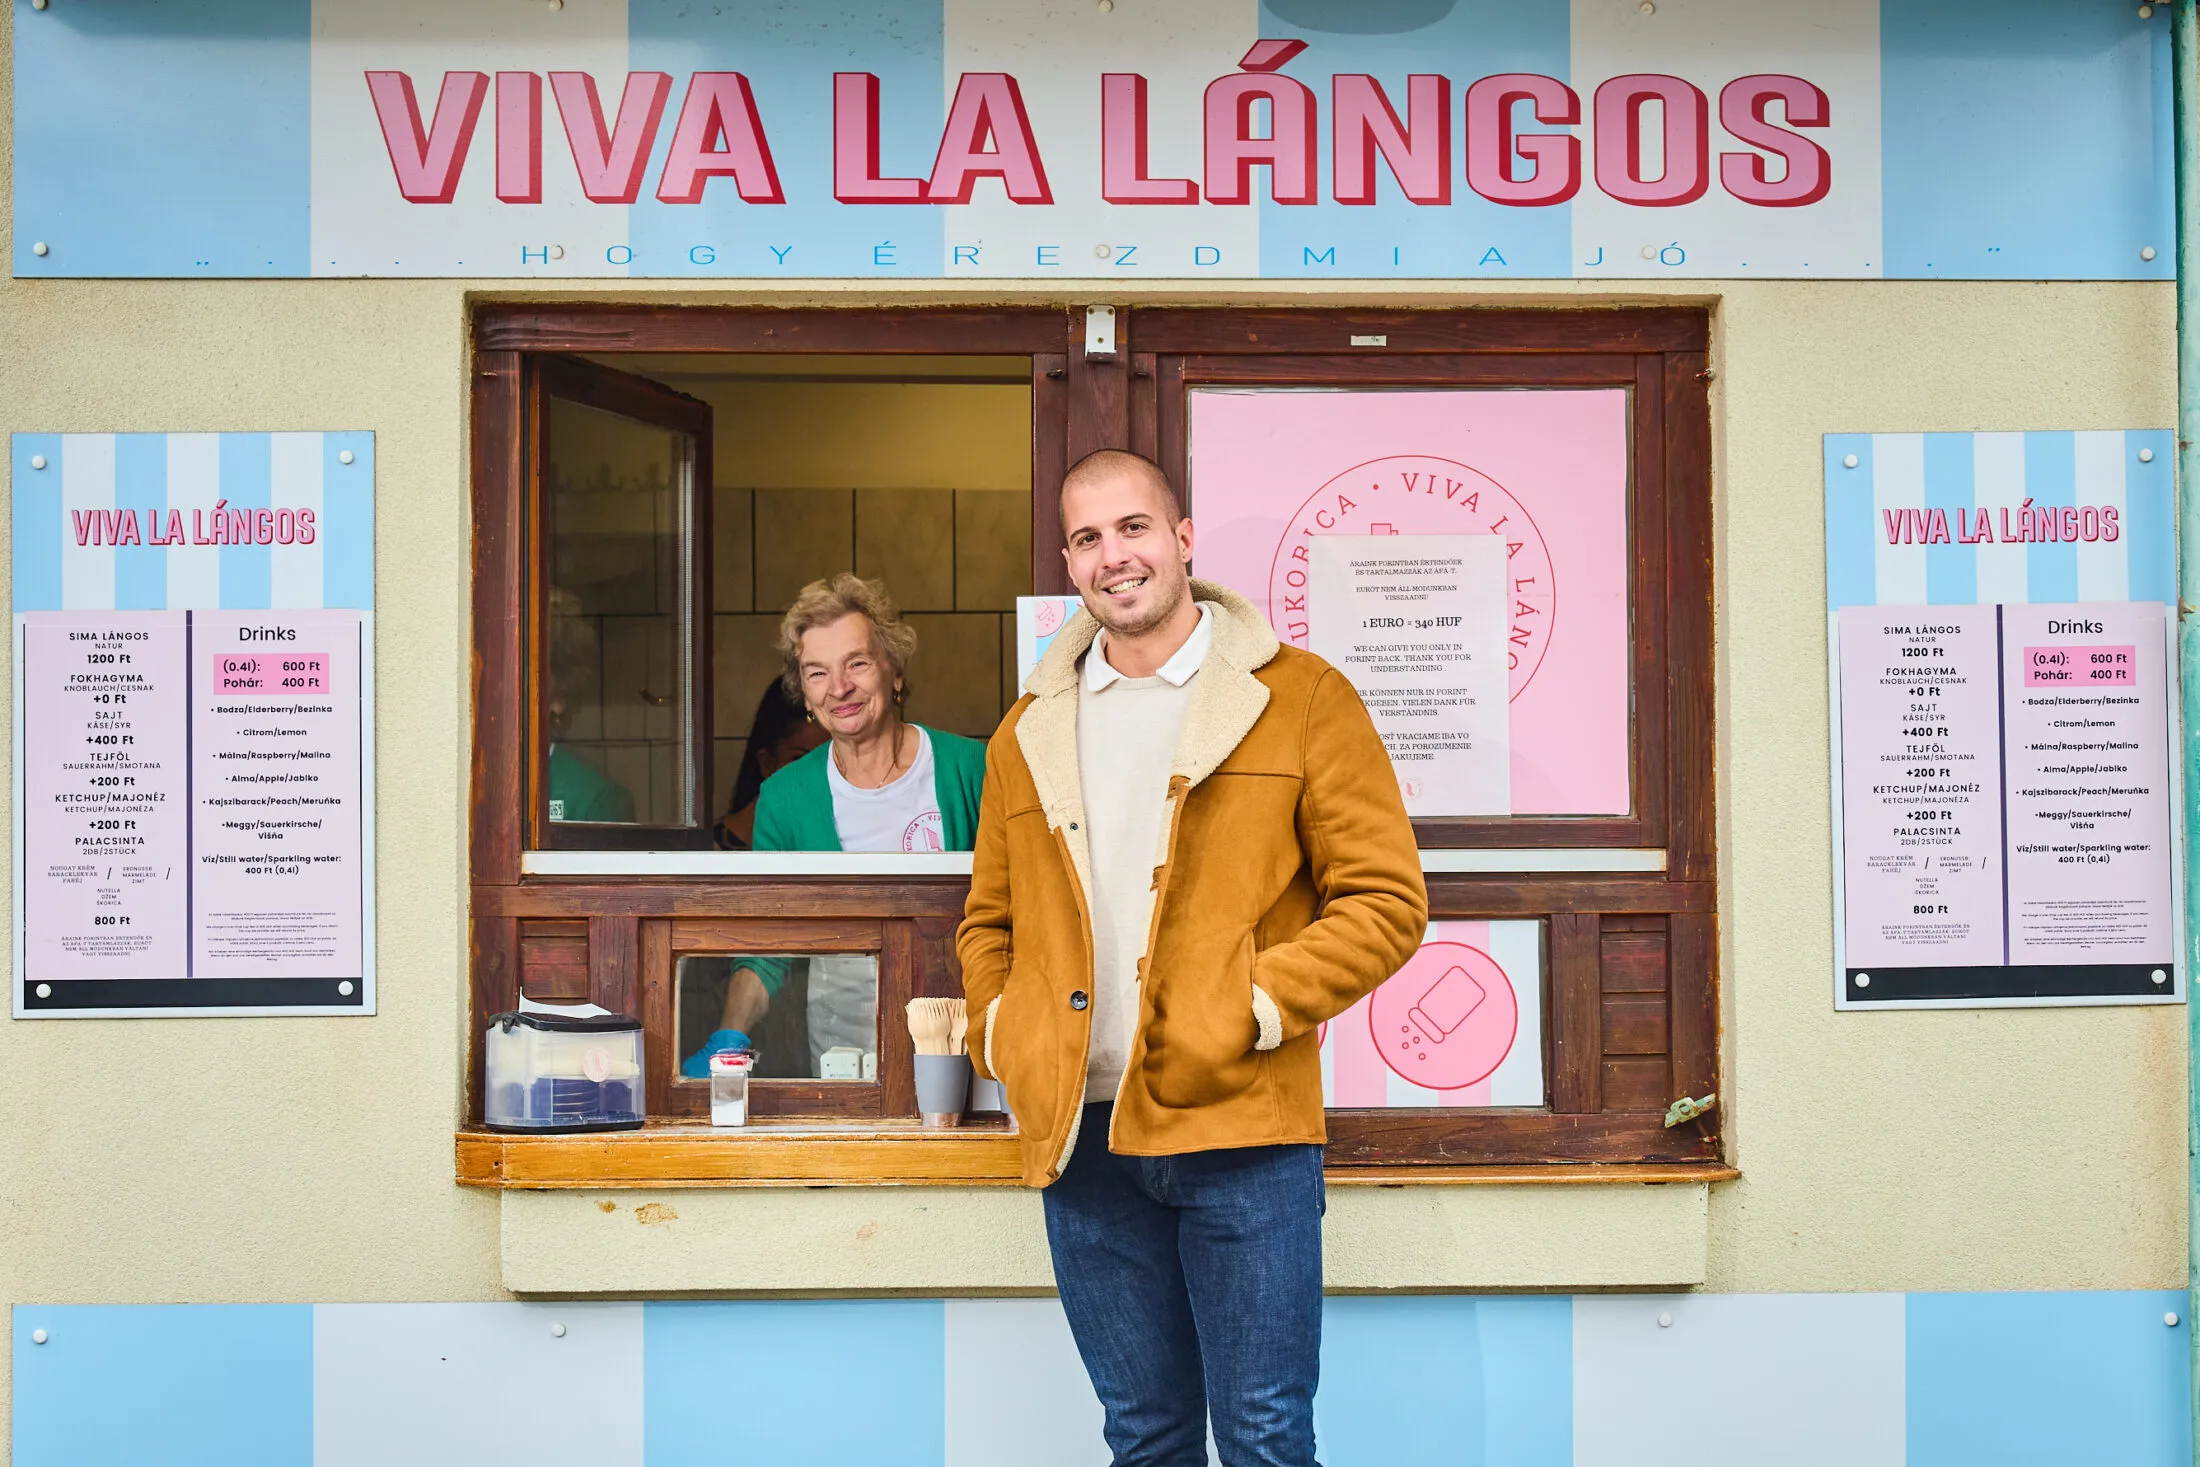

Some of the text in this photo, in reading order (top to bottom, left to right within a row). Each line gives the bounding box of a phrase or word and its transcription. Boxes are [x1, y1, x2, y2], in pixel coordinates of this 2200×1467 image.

[365, 40, 1833, 209] VIVA LA LÁNGOS
[874, 241, 1221, 265] ÉREZD
[1480, 247, 1507, 266] A
[1401, 472, 1480, 513] VIVA
[72, 499, 314, 545] VIVA LA LÁNGOS
[1883, 497, 2119, 544] VIVA LA LÁNGOS
[1369, 617, 1404, 628] EURO
[1415, 619, 1434, 629] 340
[1436, 616, 1462, 627] HUF
[2048, 619, 2103, 634] Drinks
[239, 626, 296, 641] Drinks
[1883, 624, 1961, 635] SIMA LÁNGOS
[69, 630, 149, 641] SIMA LÁNGOS
[1901, 647, 1944, 657] 1200 Ft
[87, 654, 131, 664] 1200 Ft
[2090, 653, 2113, 664] 600
[2116, 653, 2127, 663] Ft
[282, 661, 306, 672] 600
[309, 661, 320, 671] Ft
[1370, 664, 1443, 673] UNDERSTANDING
[1886, 667, 1957, 676] FOKHAGYMA
[70, 674, 144, 683] FOKHAGYMA
[2034, 669, 2127, 680] Pohár: 400 Ft
[223, 677, 320, 688] Pohár: 400 Ft
[1879, 676, 1967, 685] KNOBLAUCH/CESNAK
[64, 683, 154, 692] KNOBLAUCH/CESNAK
[1369, 688, 1405, 696] KÖNNEN
[1908, 686, 1941, 697] +0 Ft
[93, 694, 127, 704] +0 Ft
[1459, 698, 1476, 706] FÜR
[2028, 695, 2140, 706] Bodza/Elderberry/Bezinka
[217, 704, 333, 715] Bodza/Elderberry/Bezinka
[1910, 703, 1937, 712] SAJT
[95, 711, 122, 720] SAJT
[2053, 718, 2116, 728] Citrom/Lemon
[242, 727, 307, 738] Citrom/Lemon
[1396, 732, 1441, 740] VRACIAME
[1902, 727, 1949, 737] +400 Ft
[86, 735, 134, 745] +400 Ft
[1906, 742, 1945, 754] TEJFÖL
[90, 750, 130, 763] TEJFÖL
[1880, 753, 1975, 762] SAUERRAHM/SMOTANA
[63, 761, 161, 770] SAUERRAHM/SMOTANA
[2043, 763, 2128, 775] Alma/Apple/Jablko
[231, 773, 319, 784] Alma/Apple/Jablko
[1906, 768, 1951, 778] +200 Ft
[89, 776, 135, 786] +200 Ft
[1873, 782, 1980, 795] KETCHUP/MAJONÉZ
[55, 791, 166, 804] KETCHUP/MAJONÉZ
[1906, 810, 1952, 821] +200 Ft
[89, 820, 136, 830] +200 Ft
[1893, 827, 1961, 836] PALACSINTA
[75, 836, 145, 846] PALACSINTA
[2051, 842, 2122, 854] water/Sparkling
[238, 853, 311, 865] water/Sparkling
[1913, 905, 1948, 915] 800 Ft
[94, 915, 130, 926] 800 Ft
